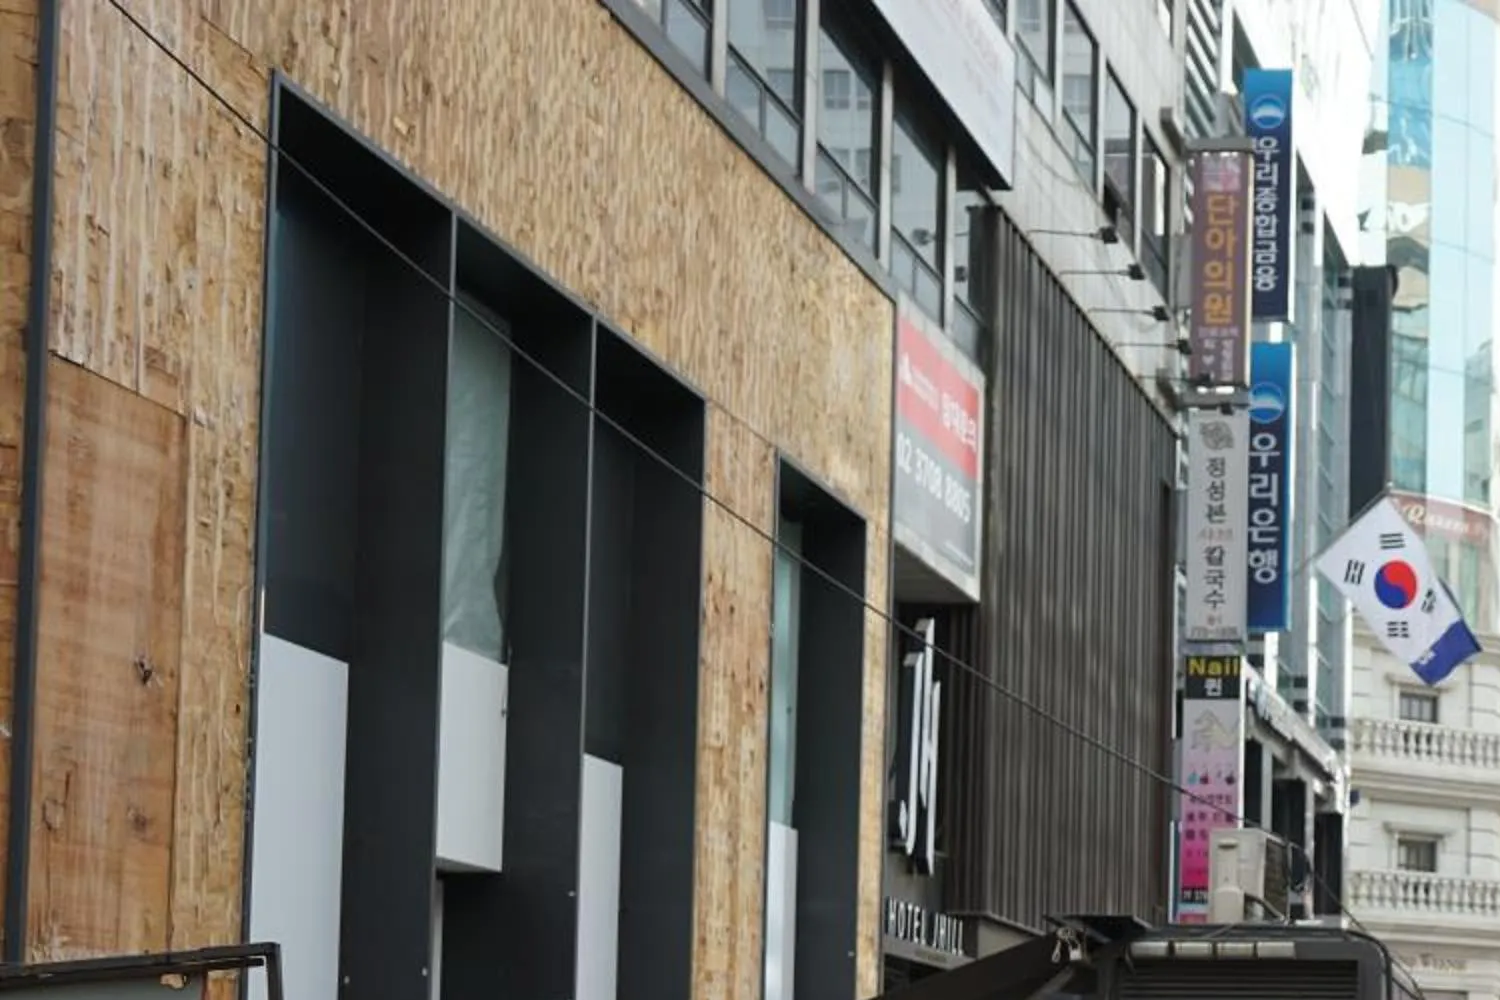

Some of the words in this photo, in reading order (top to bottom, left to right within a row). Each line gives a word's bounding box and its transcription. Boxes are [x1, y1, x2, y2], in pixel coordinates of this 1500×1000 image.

[1249, 432, 1280, 584] 우리은행
[1188, 658, 1240, 677] Nail
[887, 896, 927, 947] HOTEL
